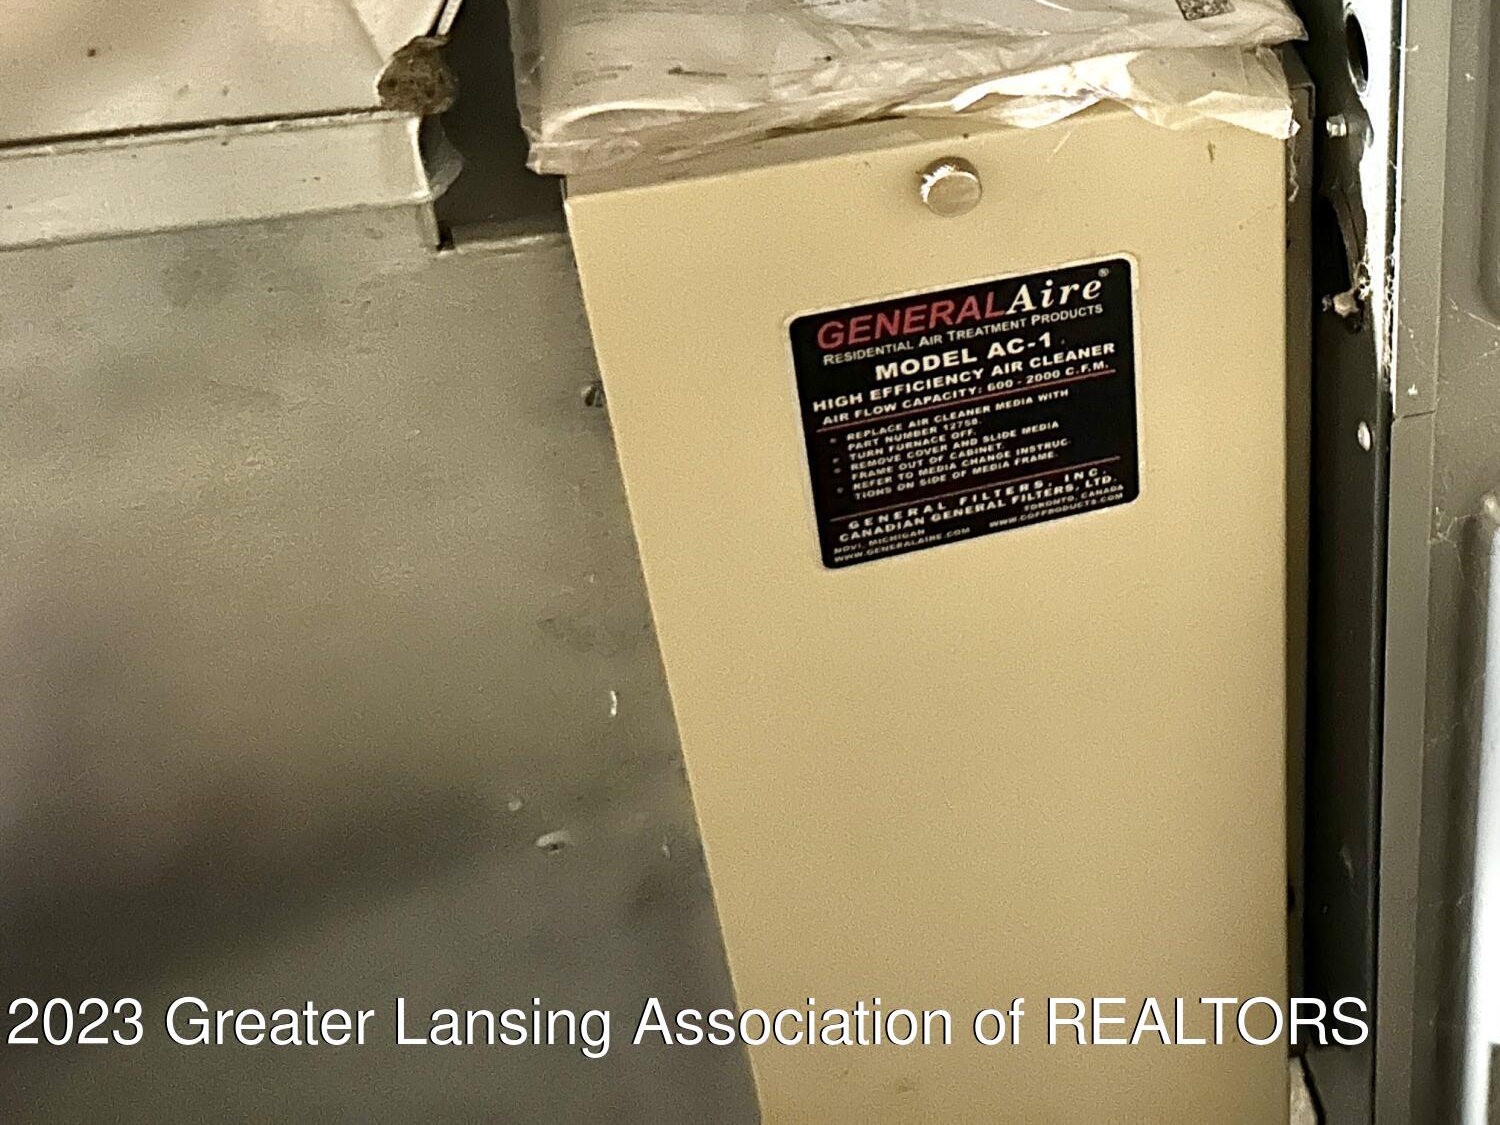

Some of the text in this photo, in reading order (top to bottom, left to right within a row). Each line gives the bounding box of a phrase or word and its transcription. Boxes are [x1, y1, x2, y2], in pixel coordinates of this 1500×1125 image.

[822, 299, 1103, 368] RESIDENTIAL AIR TREATMENT PRODUCTS
[874, 330, 1051, 381] MODEL AC-1
[812, 340, 1115, 413] HIGH EFFICIENCY AIR CLEANER
[821, 411, 849, 426] AIR
[853, 401, 897, 420] FLOW
[901, 384, 982, 410] CAPACITY:
[986, 378, 1014, 392] 600
[1025, 368, 1060, 384] 2000
[1065, 358, 1109, 376] C.F.M.
[845, 388, 1069, 442] REPLACE AIR CLEANER MEDIA WITH
[846, 437, 880, 452] PART
[883, 425, 937, 444] NUMBER
[848, 446, 884, 461] TURN
[887, 433, 946, 453] FURNACE
[849, 419, 1059, 471] REMOVE COVER AND SLIDE MEDIA
[850, 464, 894, 481] FRAME
[897, 458, 924, 471] OUT
[928, 454, 944, 465] OF
[852, 474, 893, 491] REFER
[897, 470, 914, 481] TO
[918, 461, 957, 477] MEDIA
[960, 449, 1011, 468] CHANGE
[847, 500, 947, 530] GENERAL
[1063, 465, 1107, 483] INC.
[896, 480, 915, 492] ON
[918, 473, 947, 487] SIDE
[951, 469, 967, 480] OF
[971, 459, 1010, 476] MEDIA
[838, 515, 925, 543] CANADIAN
[930, 498, 1006, 523] GENERAL
